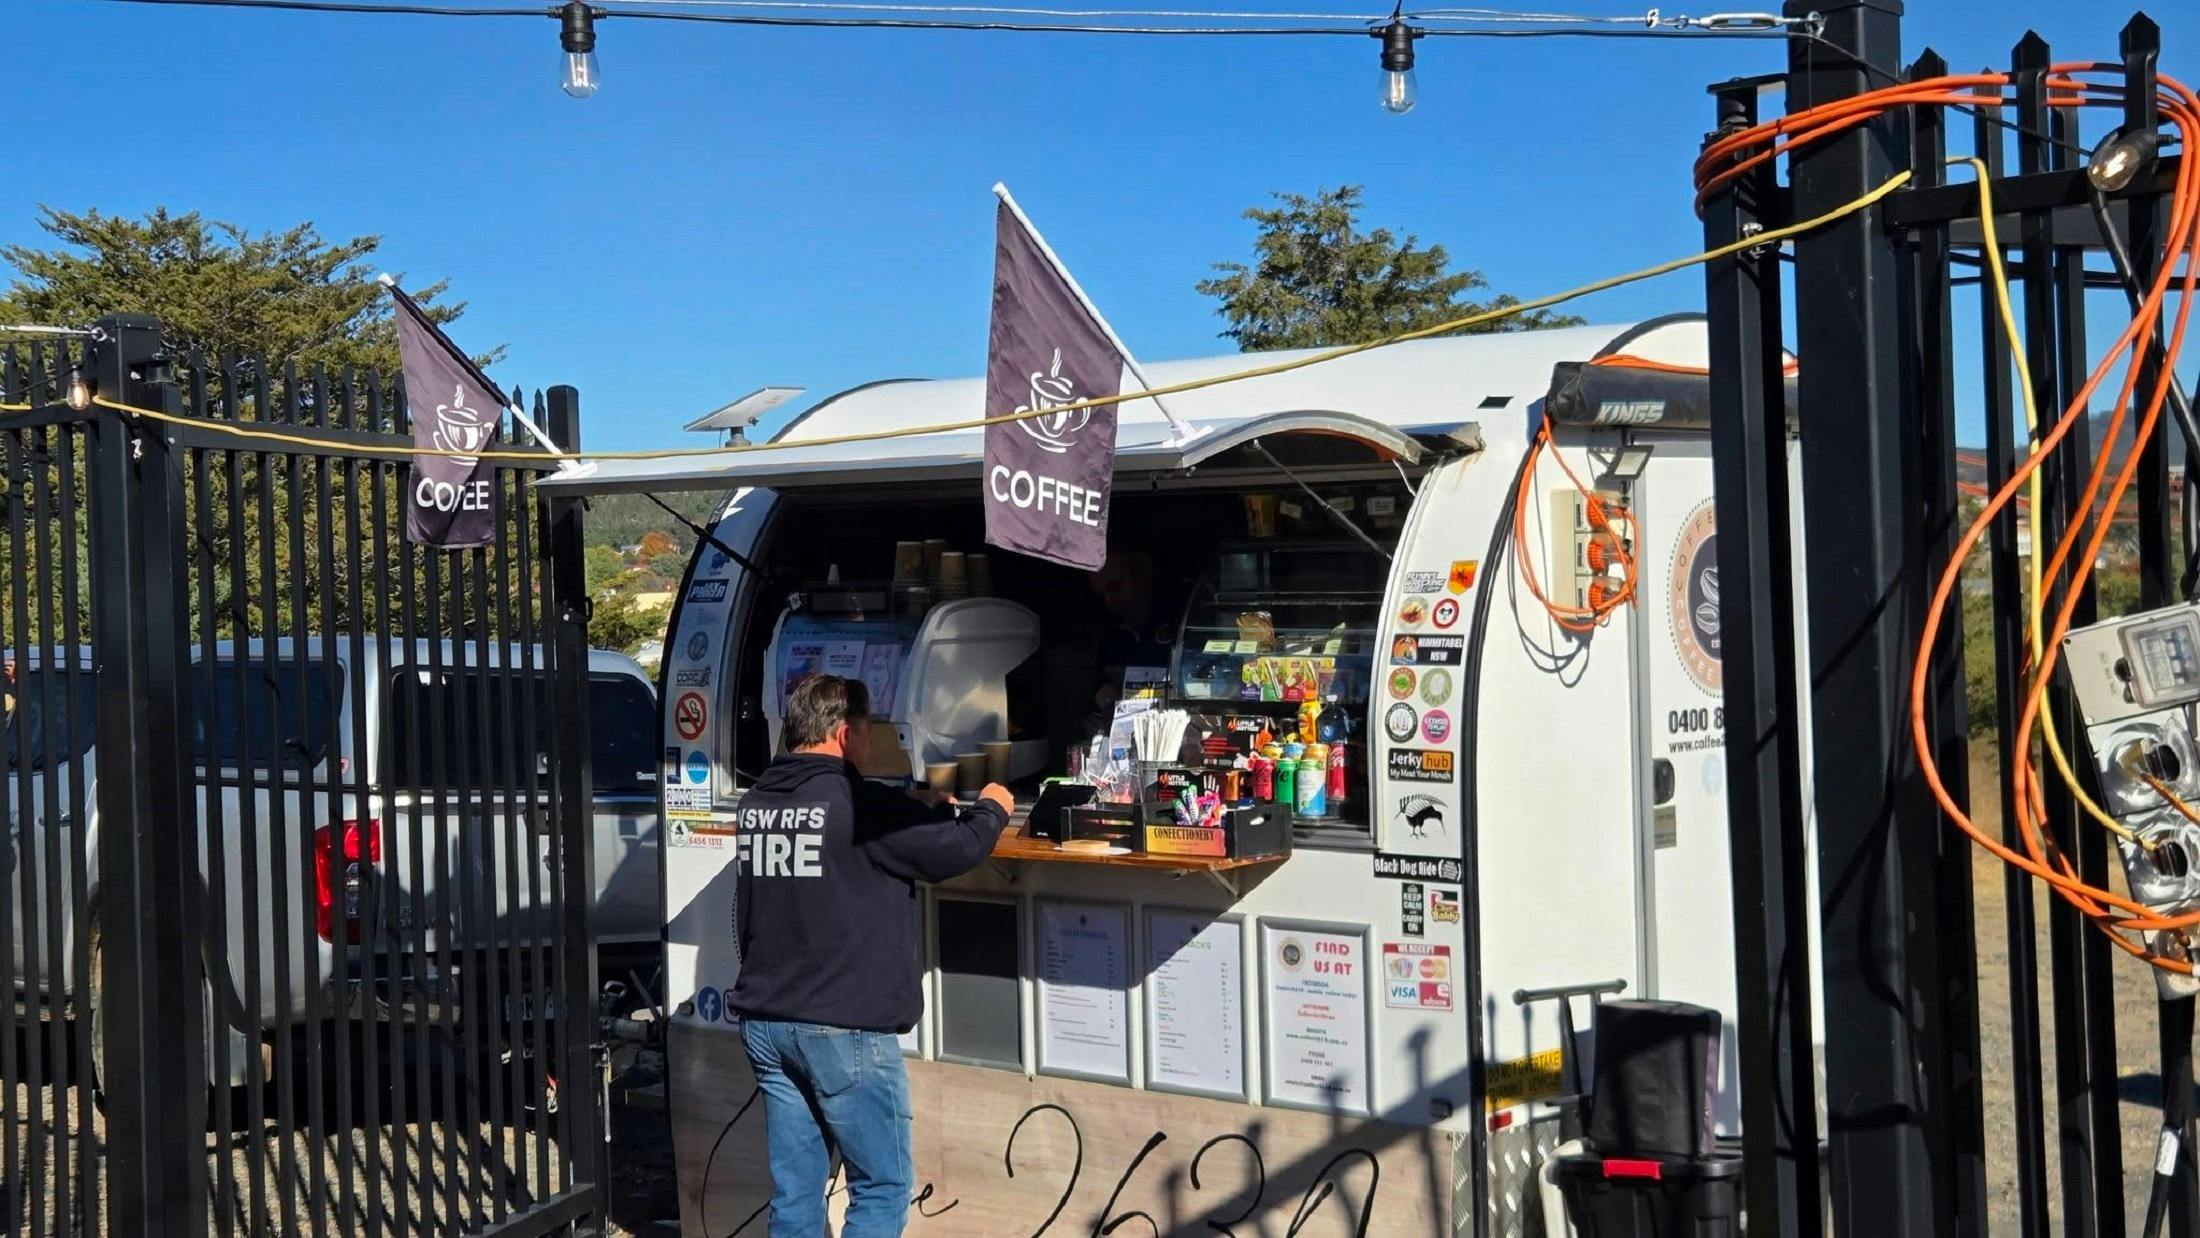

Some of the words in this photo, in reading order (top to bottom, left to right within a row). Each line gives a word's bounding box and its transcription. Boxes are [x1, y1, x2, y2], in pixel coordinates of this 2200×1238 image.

[1593, 401, 1666, 424] KINGS
[991, 465, 1102, 527] COFFEE
[1430, 651, 1448, 662] NSW
[1668, 708, 1708, 734] 0400
[1713, 707, 1724, 730] 8
[1669, 735, 1725, 753] www.coffee2
[1390, 752, 1422, 769] Jerky
[1426, 755, 1449, 768] hub
[780, 807, 825, 829] RFS
[1154, 827, 1214, 841] CONFECTIONERY
[737, 834, 823, 877] FIRE
[1374, 858, 1398, 874] Black
[1400, 859, 1417, 876] Dog
[1419, 862, 1437, 876] Ride
[1403, 893, 1422, 901] KEEP
[1403, 901, 1422, 910] CALM
[1402, 915, 1423, 923] CARRY
[1315, 942, 1350, 956] FIND
[1398, 944, 1408, 952] WE
[1409, 945, 1434, 954] ACCEPT
[1314, 961, 1330, 974] US
[1334, 962, 1353, 976] AT
[1391, 987, 1416, 998] VISA
[1487, 1067, 1499, 1082] DO
[1501, 1063, 1518, 1078] NOT
[1519, 1051, 1559, 1074] OVERTAKE
